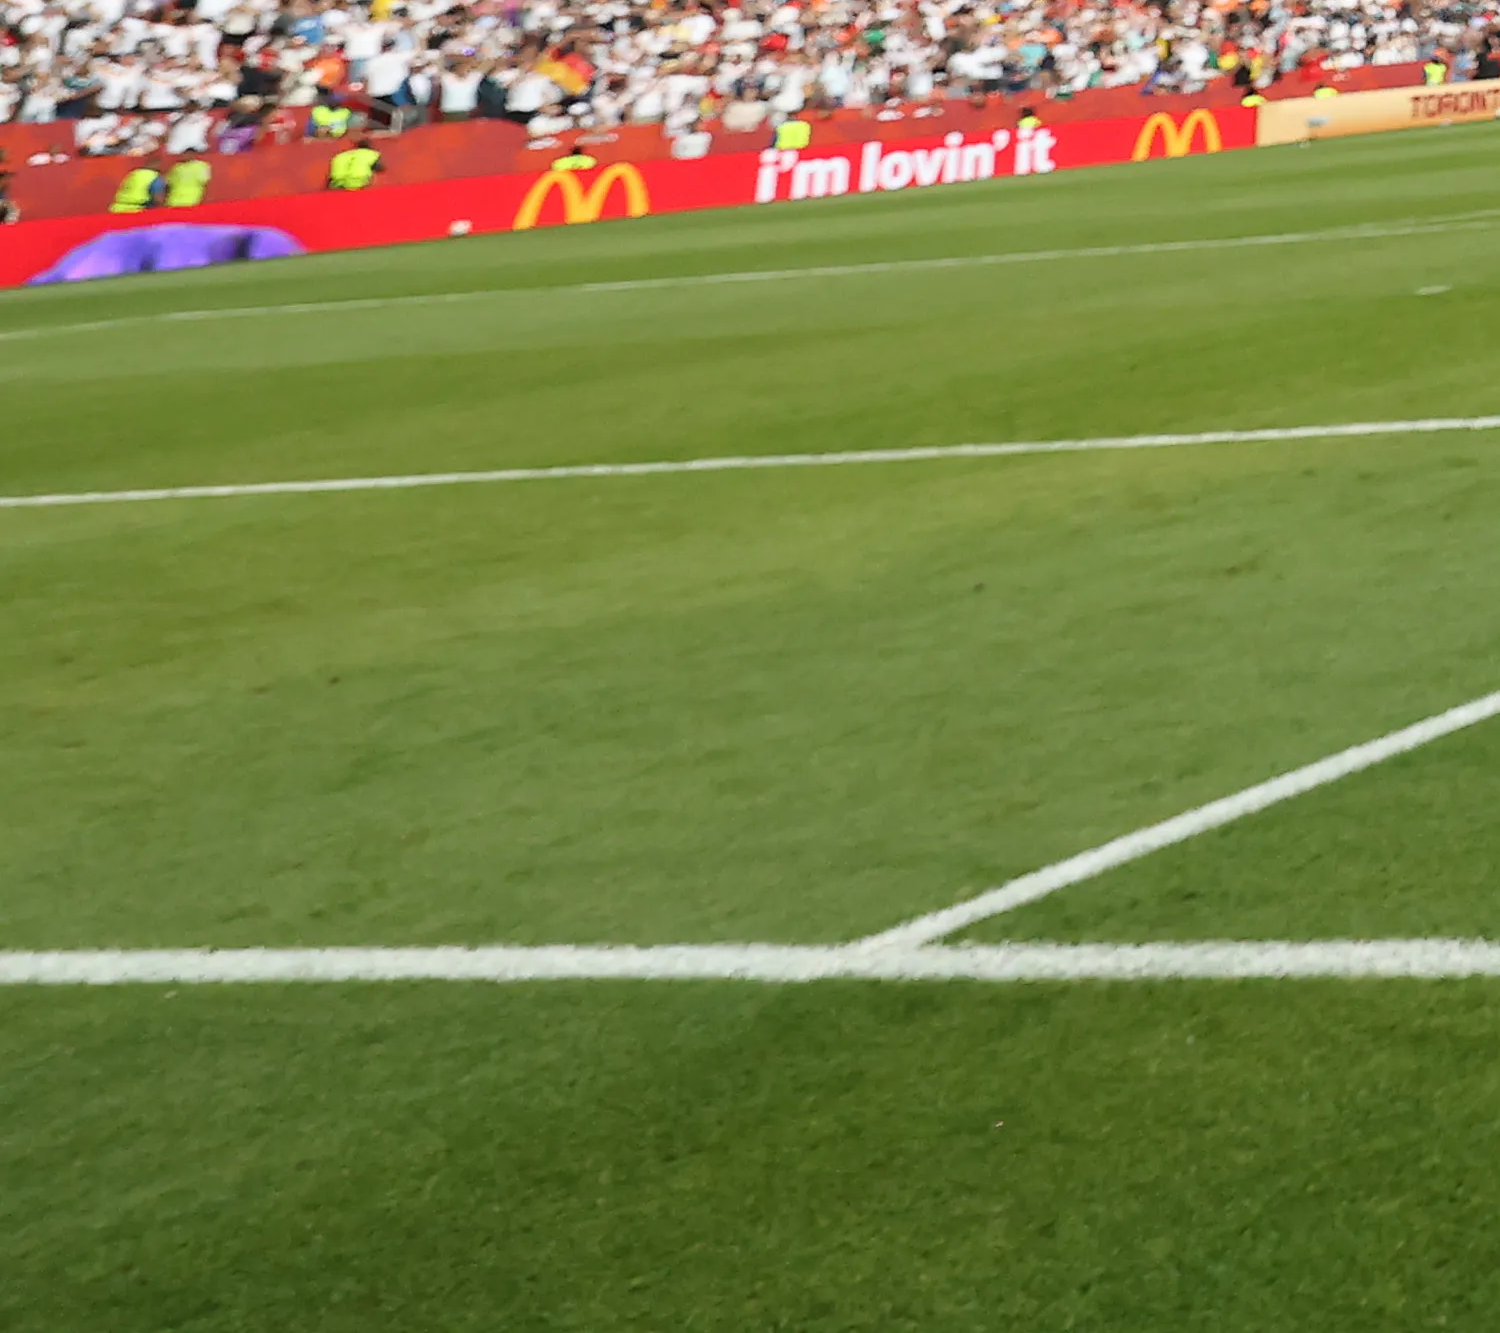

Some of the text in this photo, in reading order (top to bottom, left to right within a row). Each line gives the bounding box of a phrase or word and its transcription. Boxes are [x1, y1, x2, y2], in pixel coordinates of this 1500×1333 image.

[754, 127, 1057, 204] i'm lovin' it
